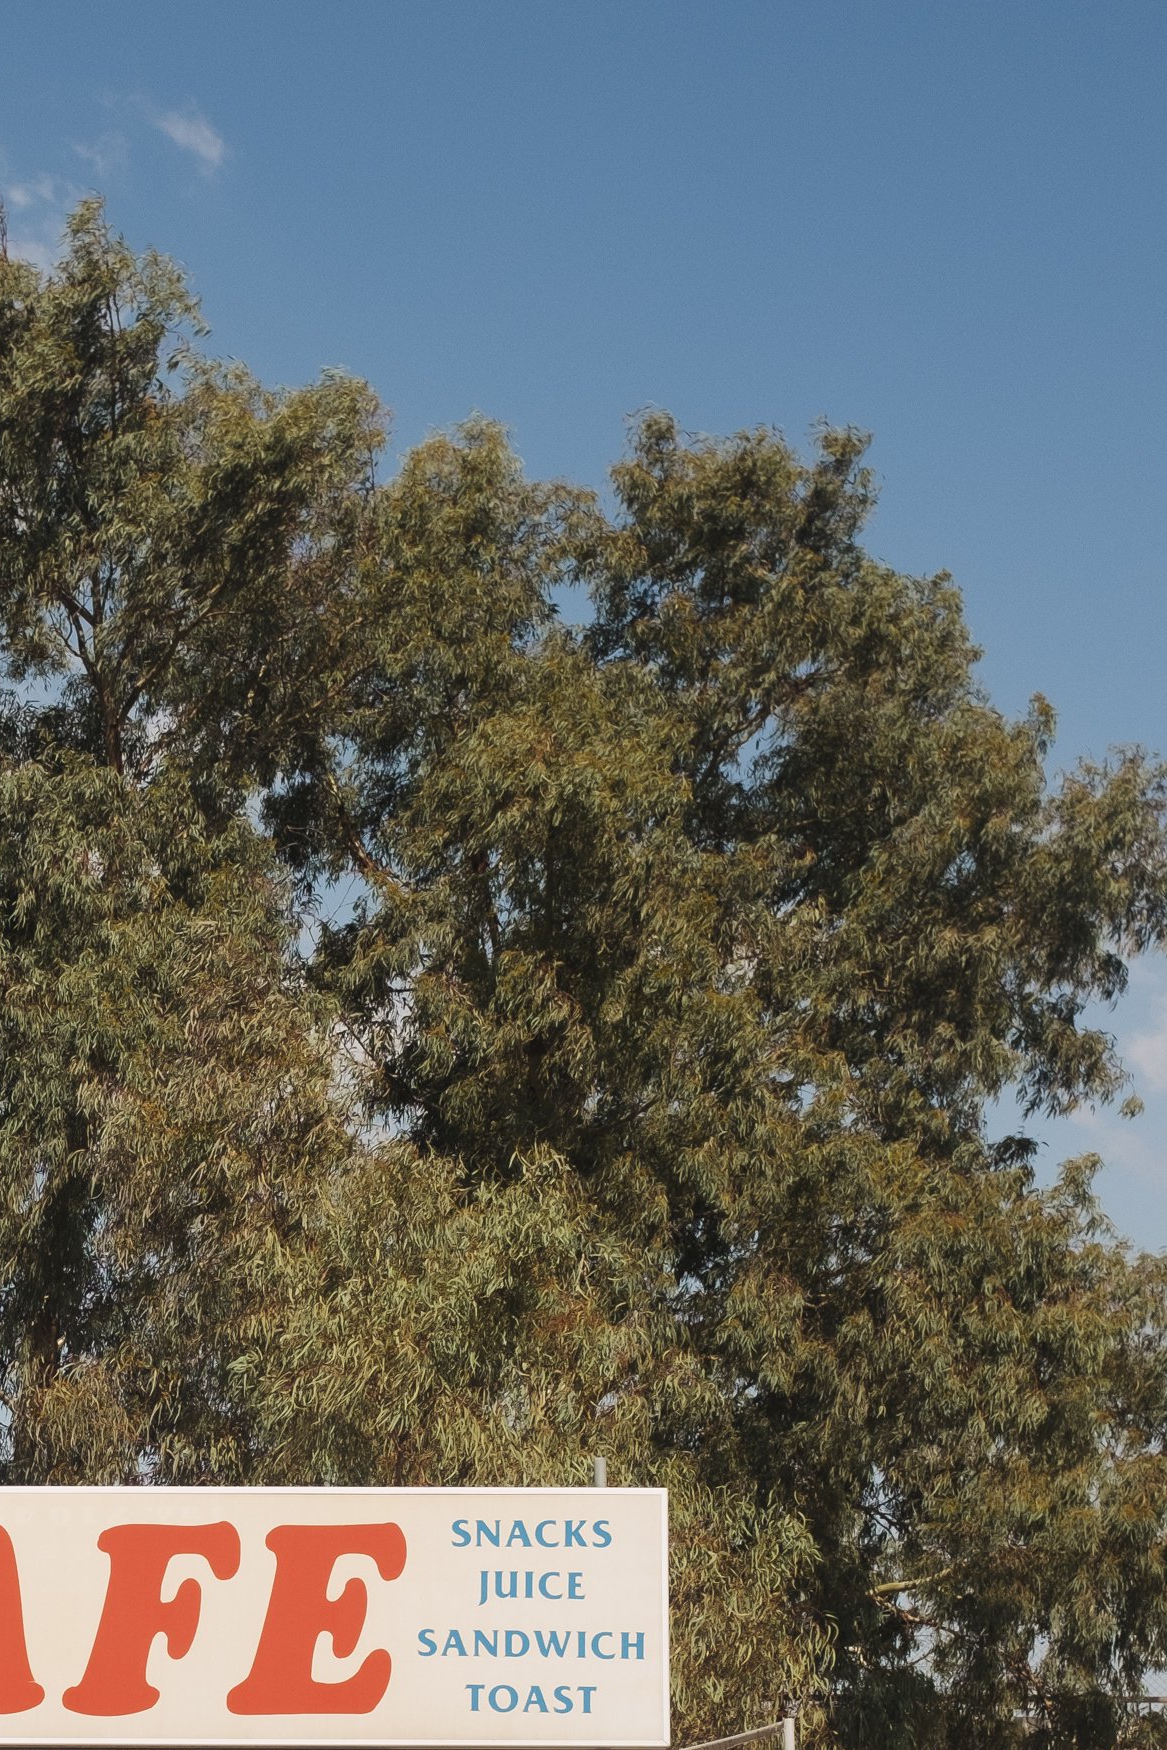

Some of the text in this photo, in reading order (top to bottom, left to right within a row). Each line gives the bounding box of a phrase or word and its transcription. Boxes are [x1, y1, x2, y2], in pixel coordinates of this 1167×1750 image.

[451, 1519, 613, 1549] SNACKS
[479, 1569, 585, 1605] JUICE
[417, 1628, 645, 1661] SANDWICH
[465, 1683, 596, 1714] TOAST
